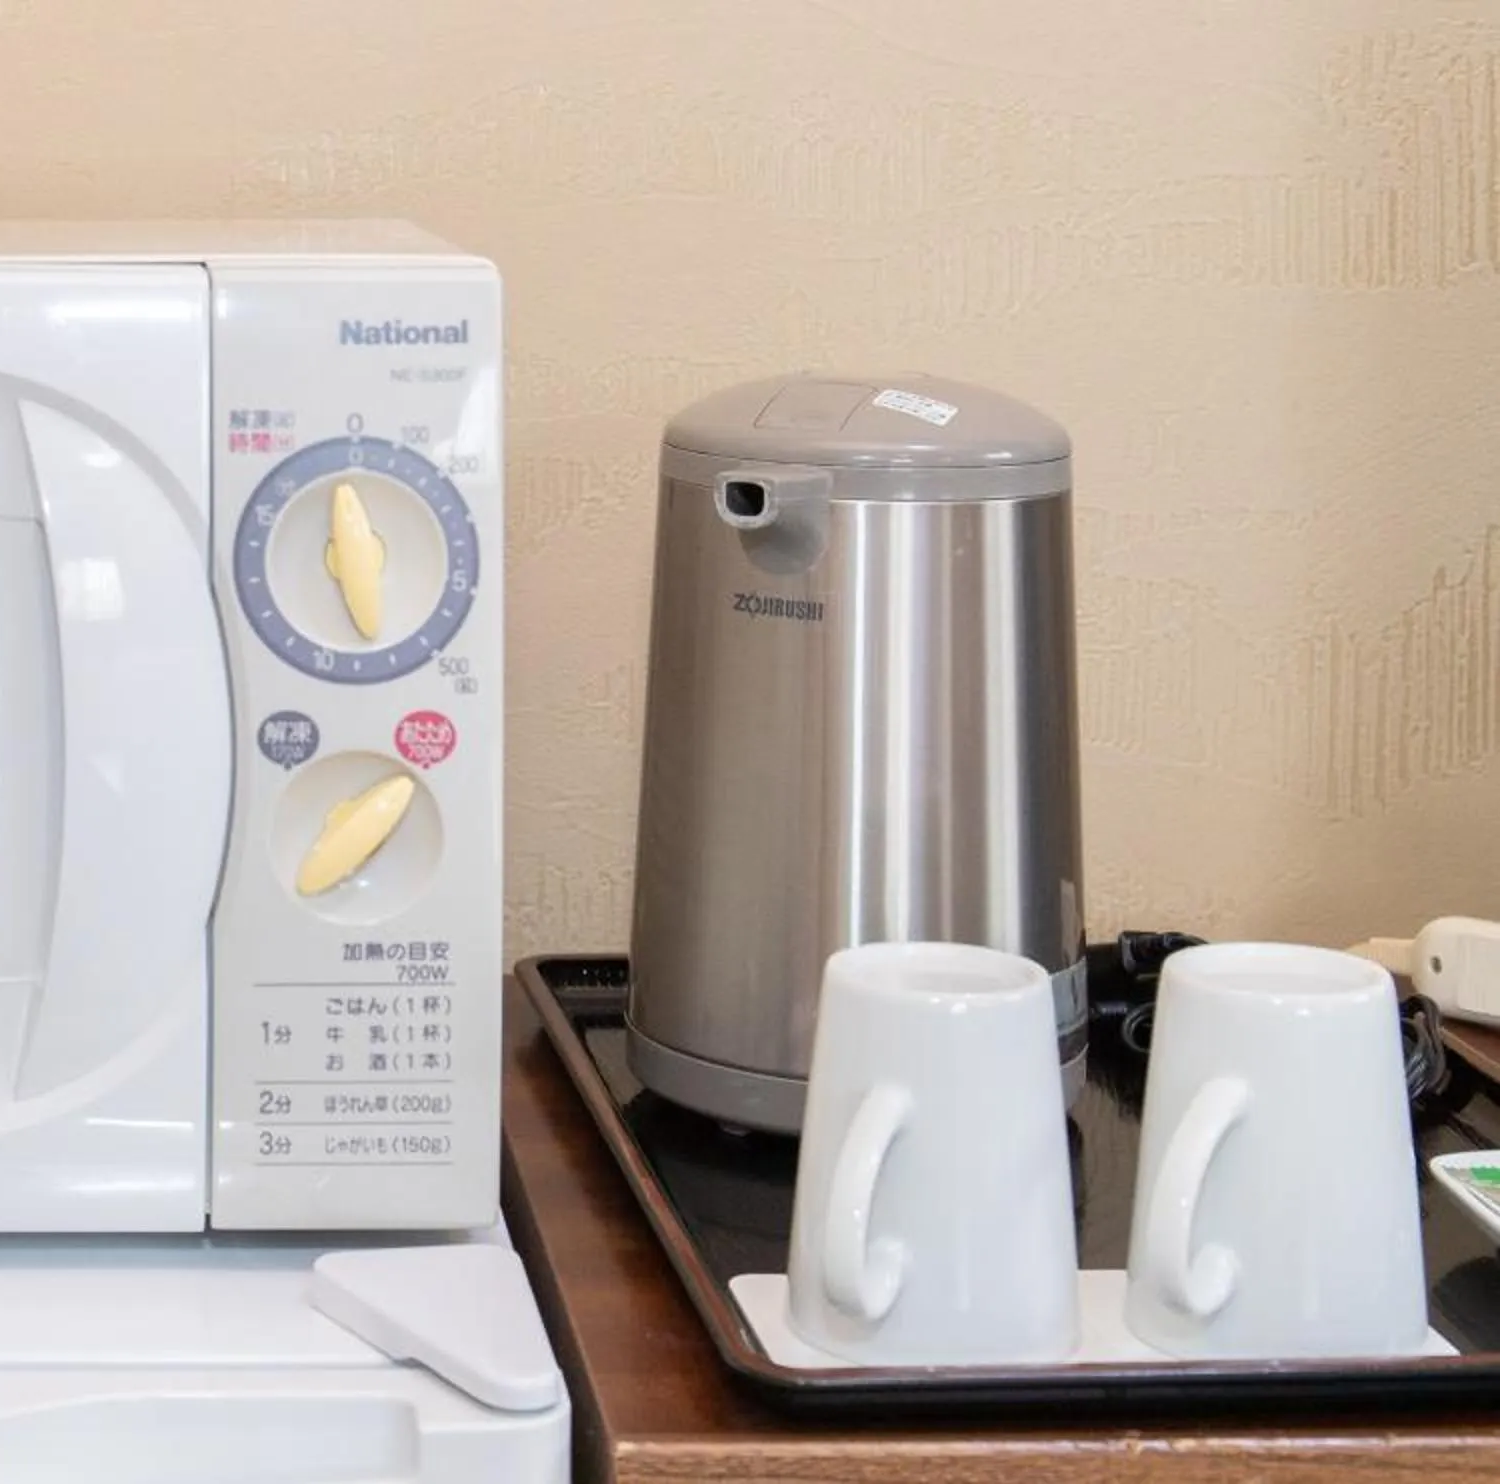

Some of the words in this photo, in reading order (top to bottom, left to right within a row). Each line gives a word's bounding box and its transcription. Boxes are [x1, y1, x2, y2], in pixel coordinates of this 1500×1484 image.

[339, 319, 469, 345] National
[346, 413, 364, 434] 0
[402, 426, 430, 444] 100
[448, 456, 479, 474] 200
[451, 570, 467, 591] 5
[732, 592, 824, 621] ZOJIRUSHI
[314, 651, 335, 669] 10
[438, 656, 469, 677] 500
[264, 719, 313, 743] 解凍
[401, 720, 453, 744] あたため
[343, 942, 449, 961] 加熱の目安
[396, 965, 449, 981] 700W
[261, 1021, 292, 1044] 1分
[259, 1090, 291, 1115] 2分
[259, 1131, 291, 1155] 3分
